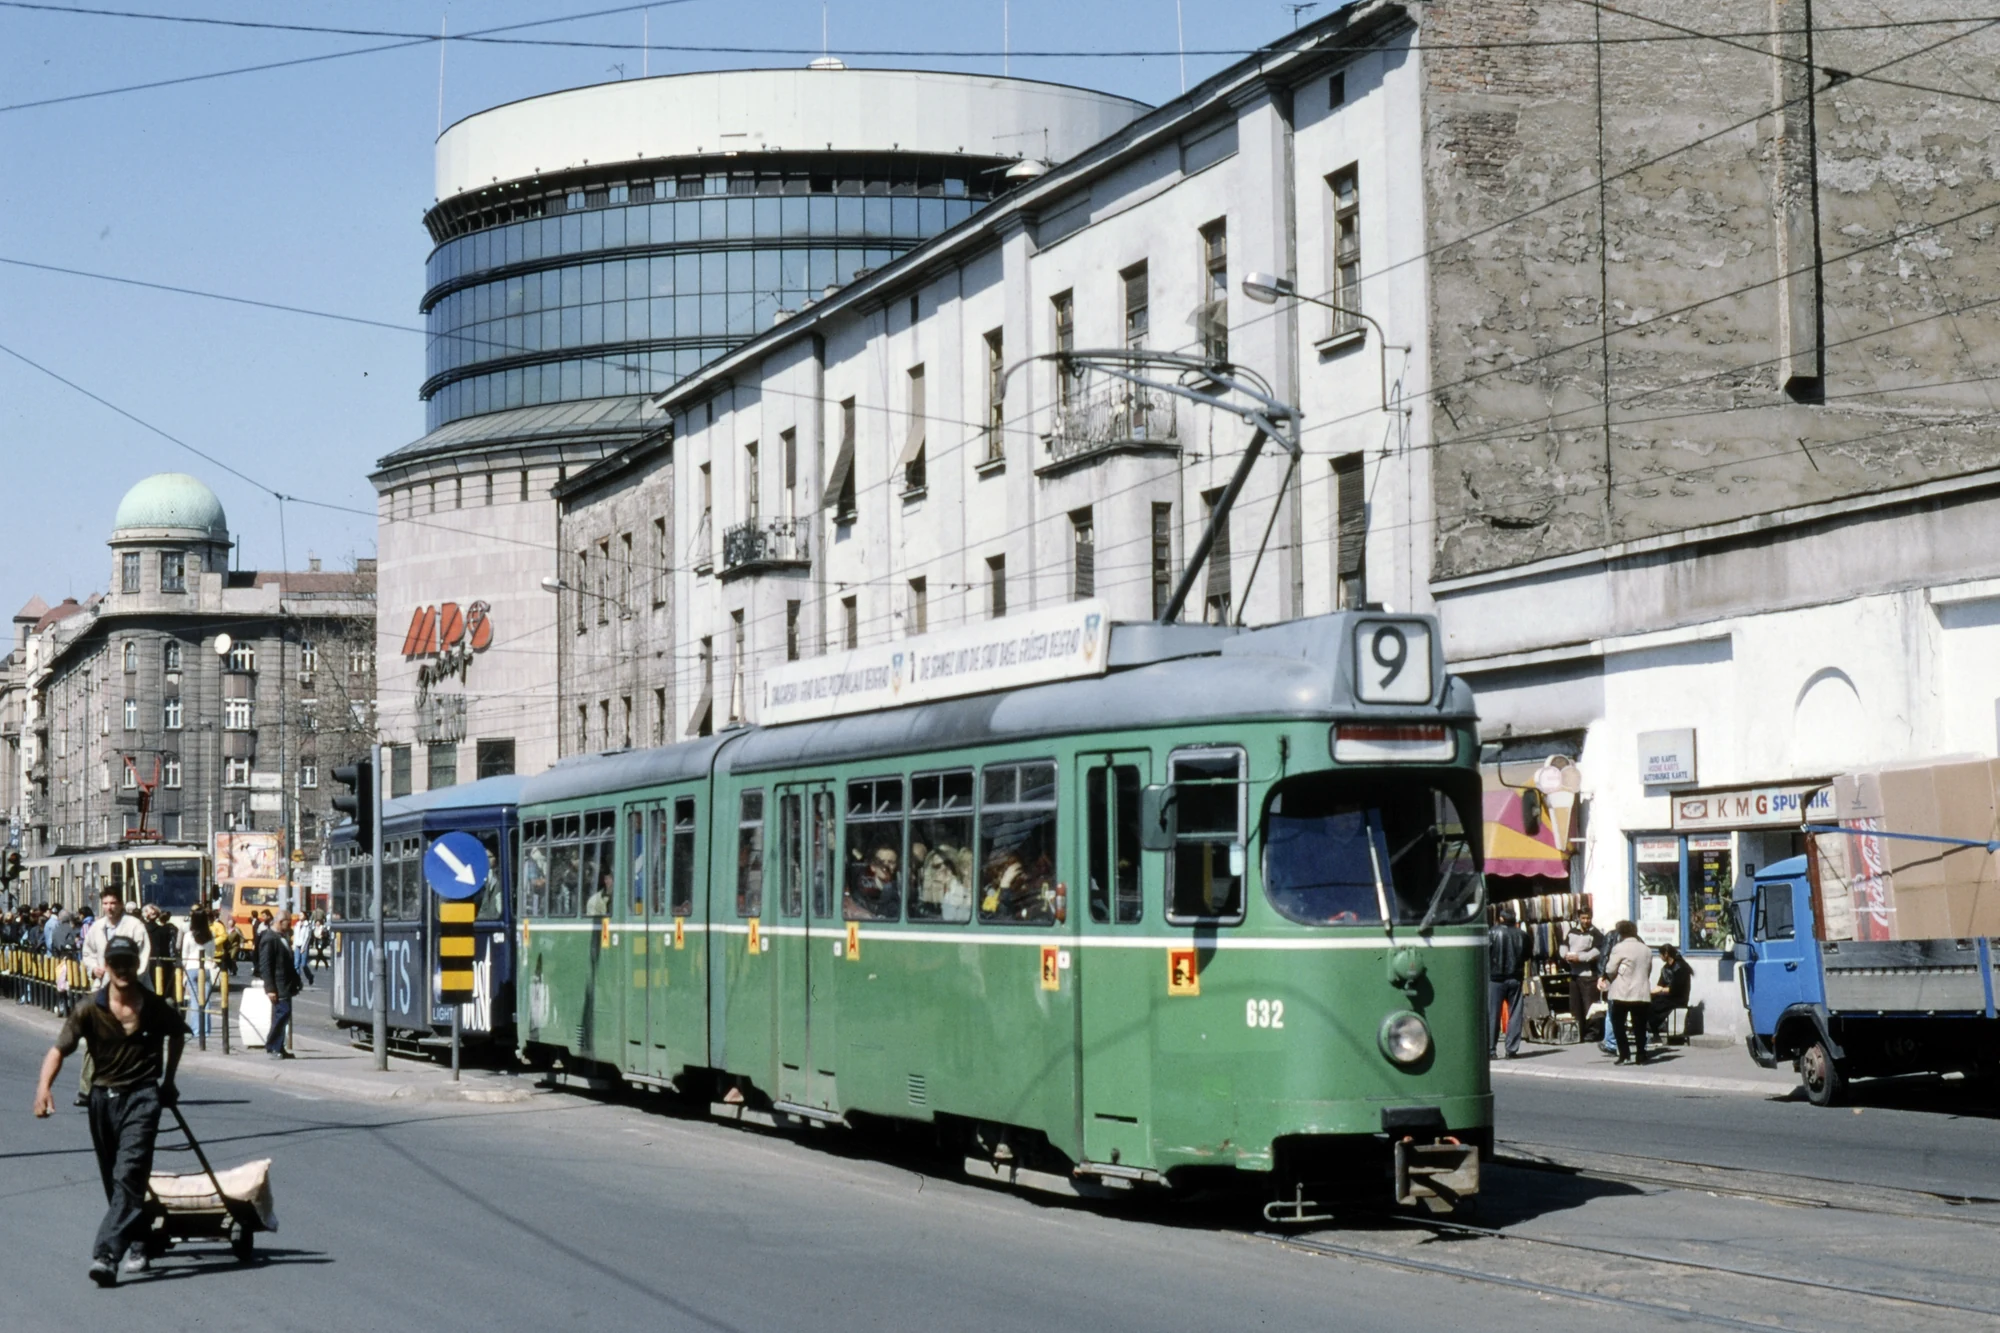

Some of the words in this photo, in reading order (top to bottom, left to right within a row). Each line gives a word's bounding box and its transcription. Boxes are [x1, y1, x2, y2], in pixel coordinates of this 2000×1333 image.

[401, 600, 494, 656] MPS
[1371, 625, 1408, 690] 9
[1773, 791, 1829, 811] SPUIK
[351, 939, 411, 1015] LIGTS
[1246, 998, 1284, 1029] 632
